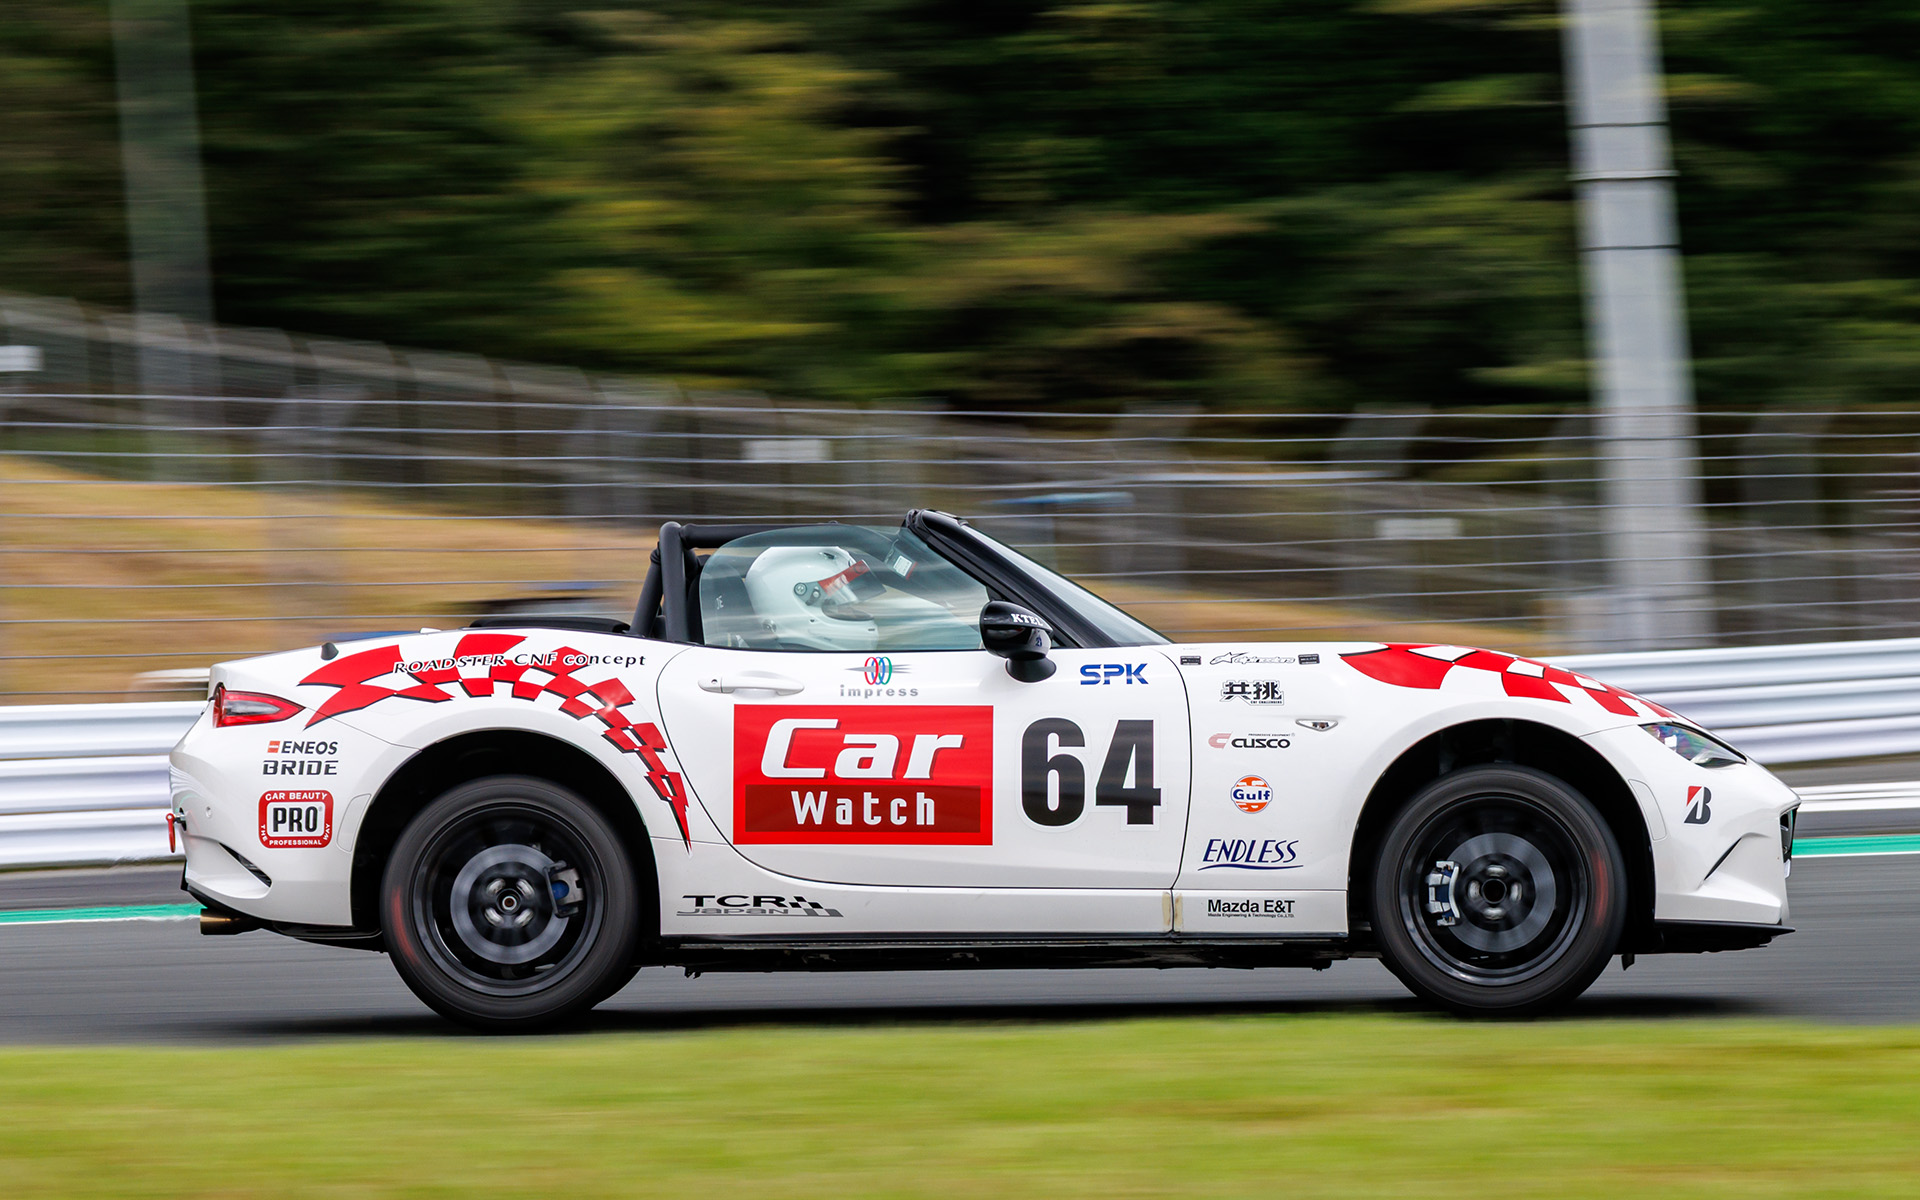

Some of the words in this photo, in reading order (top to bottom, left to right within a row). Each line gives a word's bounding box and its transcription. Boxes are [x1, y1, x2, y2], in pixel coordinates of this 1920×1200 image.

[1011, 613, 1043, 626] KTEL
[393, 653, 505, 673] ROADSTER
[514, 652, 558, 666] CNF
[565, 653, 647, 669] concept
[1080, 663, 1148, 686] SPK
[840, 685, 919, 699] impress
[1223, 681, 1282, 700] 共挑
[281, 740, 338, 756] ENEOS
[760, 718, 966, 780] Car
[262, 759, 339, 776] BRIDE
[1021, 717, 1162, 827] 64
[265, 792, 286, 801] CAR
[289, 792, 328, 801] BEAUTY
[1233, 788, 1271, 801] Gulf
[790, 790, 935, 826] Watch
[273, 805, 318, 833] PRO
[260, 824, 269, 842] THE
[322, 823, 331, 841] WAY
[1203, 838, 1299, 864] ENDLESS
[682, 894, 788, 908] TCR
[1207, 899, 1260, 913] Mazda
[1264, 899, 1295, 913] E&T
